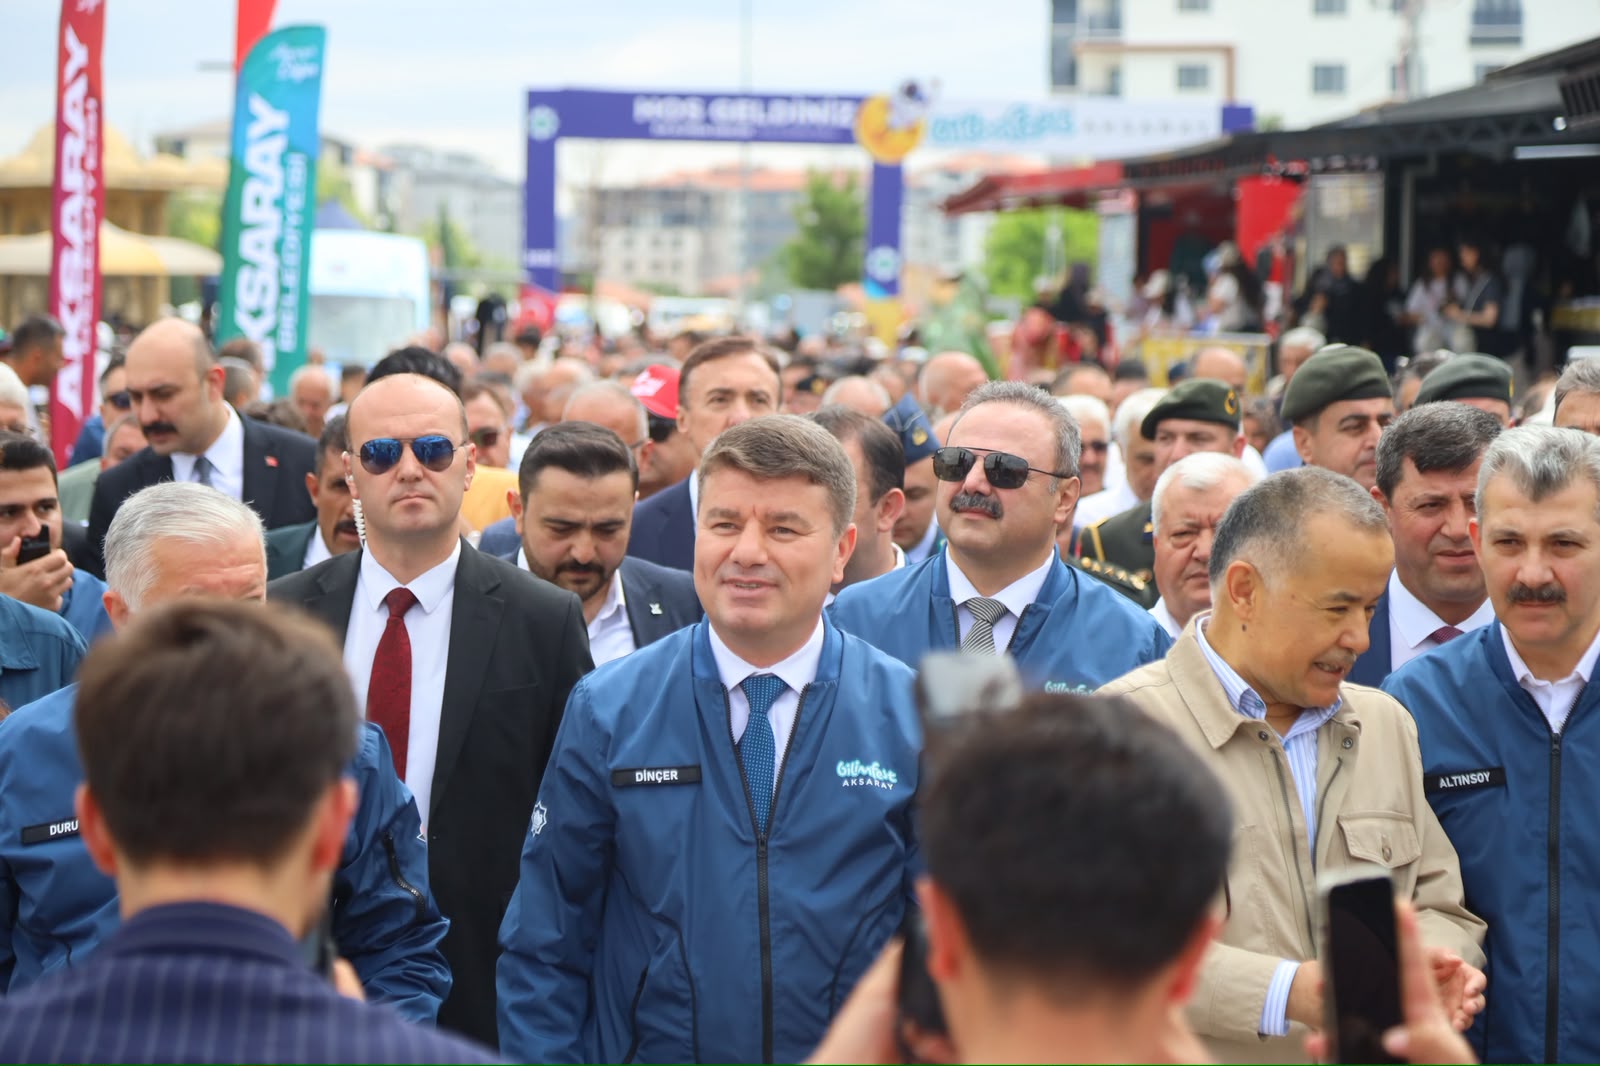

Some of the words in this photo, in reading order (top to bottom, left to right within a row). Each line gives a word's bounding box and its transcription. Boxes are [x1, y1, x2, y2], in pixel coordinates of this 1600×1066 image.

[57, 22, 88, 420] AKSARAY
[234, 94, 291, 402] KSARAY
[635, 768, 679, 783] DİNÇER
[842, 778, 894, 790] AKSARAY
[1439, 771, 1490, 788] ALTINSOY
[49, 819, 79, 836] DURU
